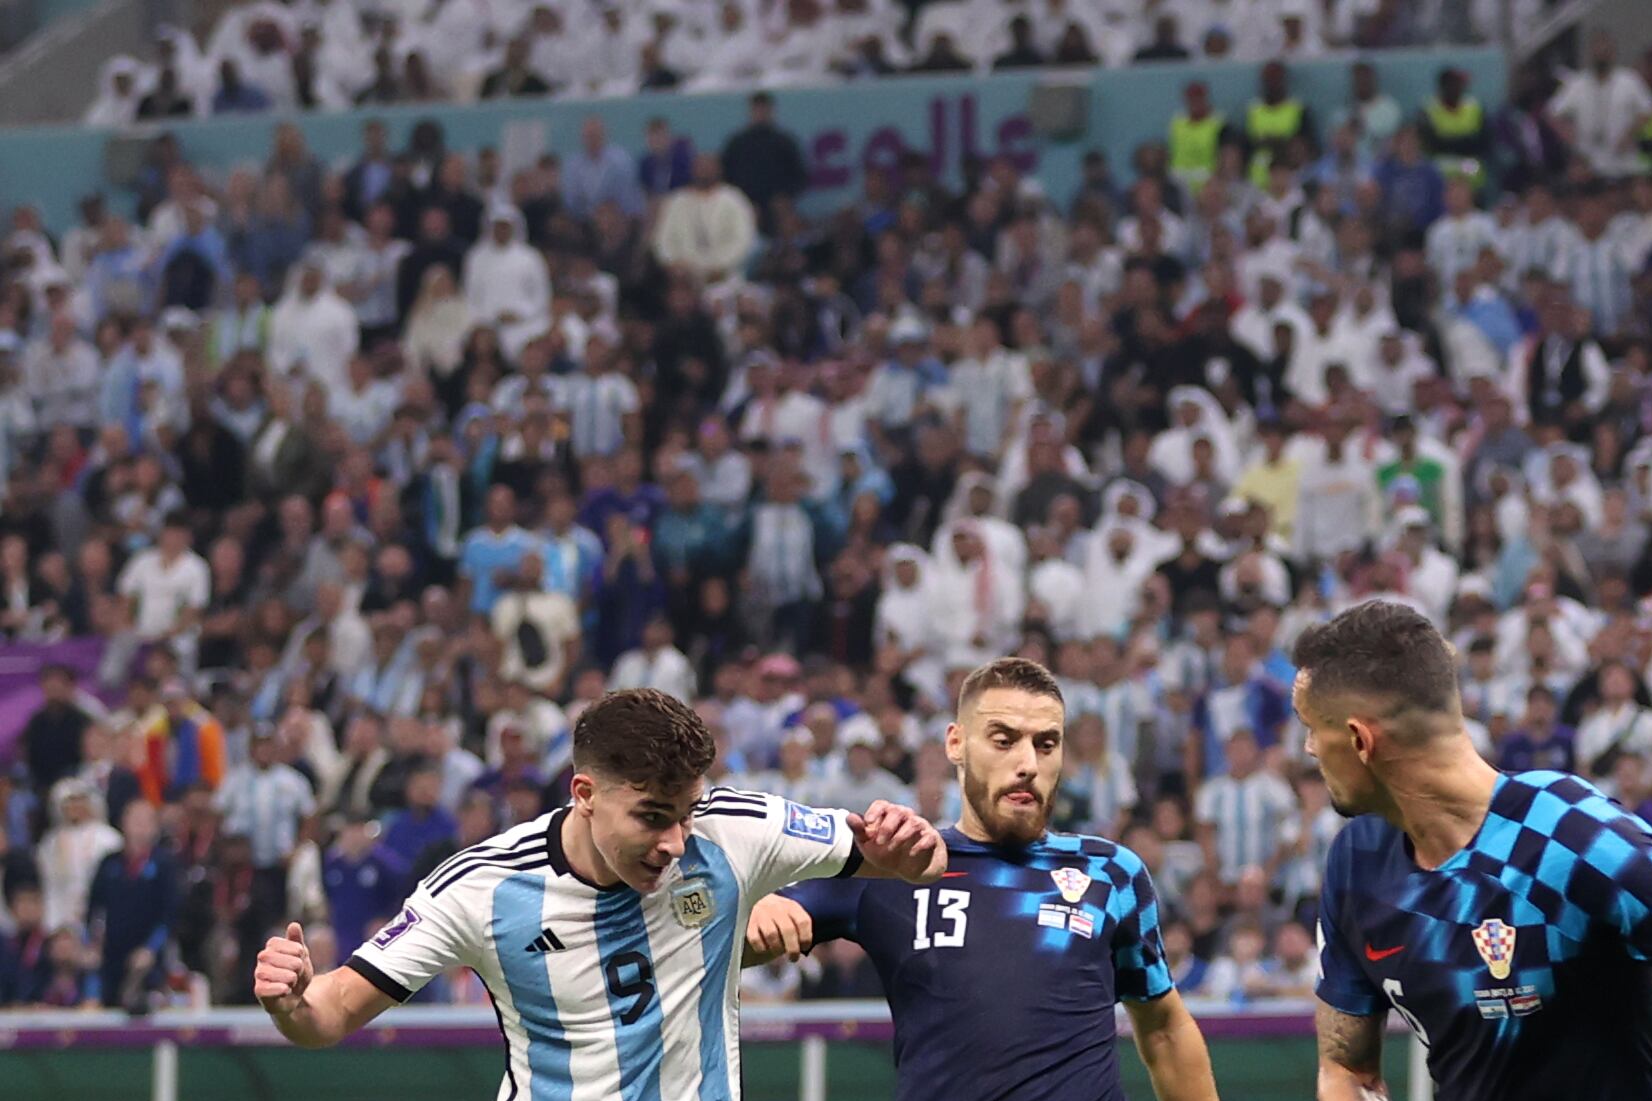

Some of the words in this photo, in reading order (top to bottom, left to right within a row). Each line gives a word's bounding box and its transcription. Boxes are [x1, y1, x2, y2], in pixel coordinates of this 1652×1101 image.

[683, 892, 706, 915] AFA
[913, 888, 971, 950] 13
[605, 951, 655, 1027] 9
